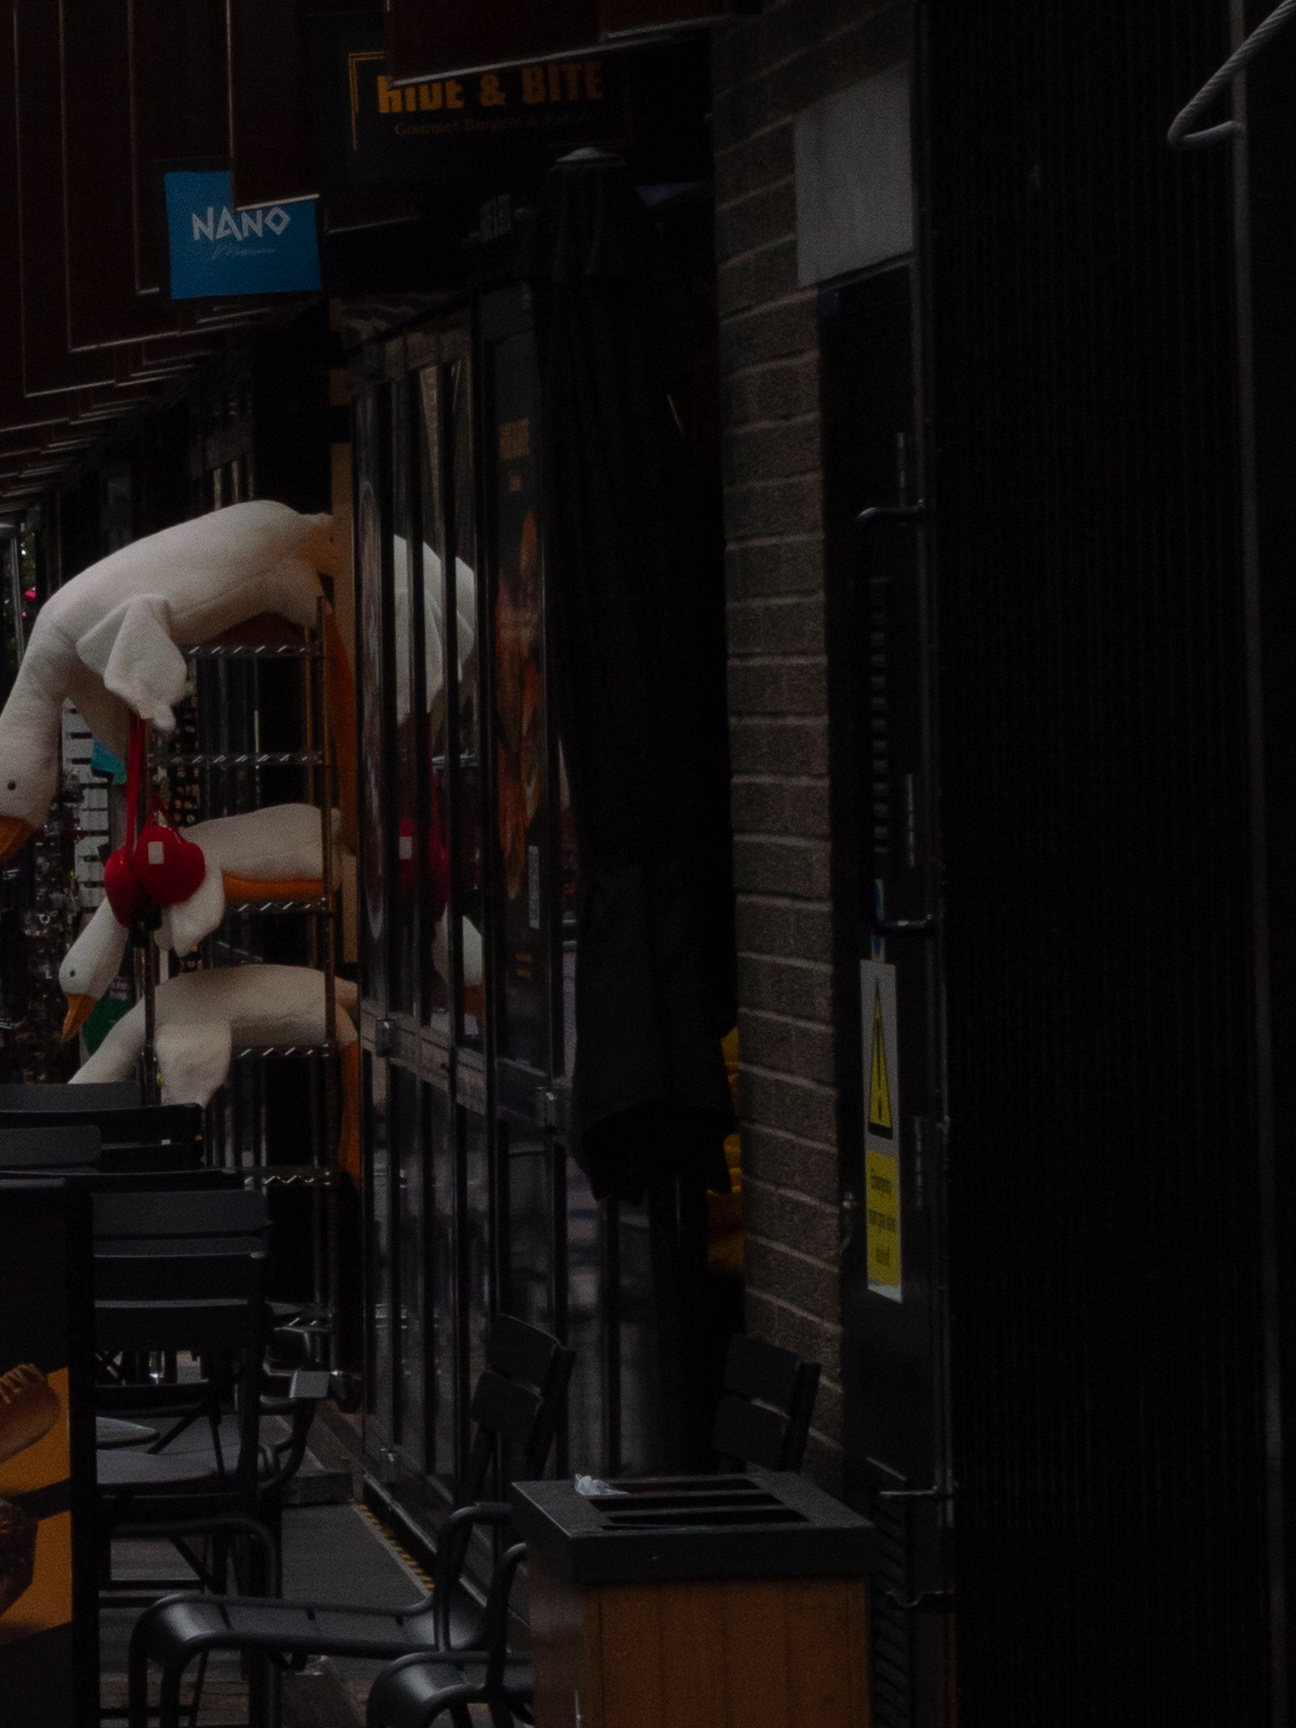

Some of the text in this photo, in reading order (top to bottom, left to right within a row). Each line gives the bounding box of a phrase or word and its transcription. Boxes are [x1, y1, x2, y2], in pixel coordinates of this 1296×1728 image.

[479, 73, 506, 108] &
[521, 61, 604, 104] BITE
[191, 205, 292, 242] NANO
